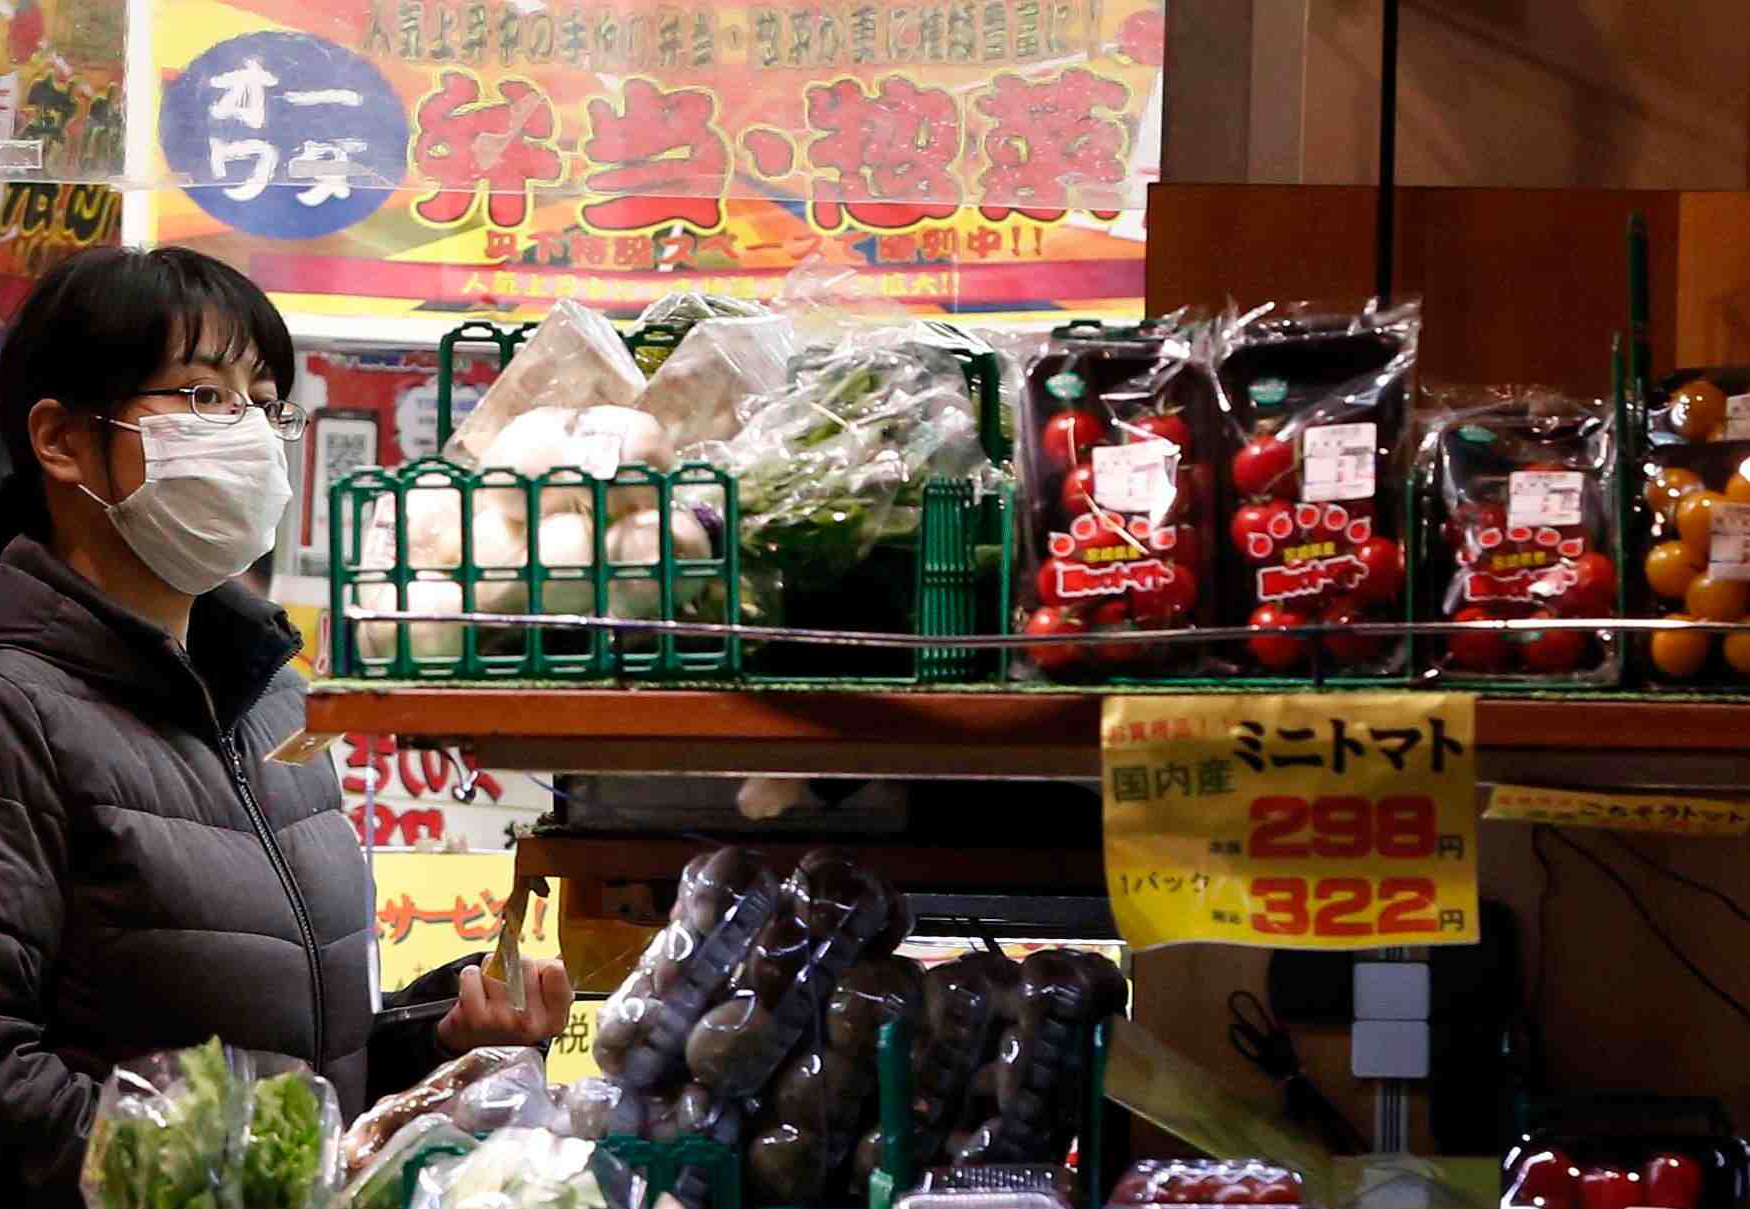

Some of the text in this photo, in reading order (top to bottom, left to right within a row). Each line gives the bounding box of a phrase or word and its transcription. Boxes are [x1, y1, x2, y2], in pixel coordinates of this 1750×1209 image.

[1234, 717, 1463, 774] ミニトマト
[1112, 759, 1236, 803] 国内産
[1249, 795, 1438, 860] 298
[1439, 834, 1464, 861] 円
[1119, 870, 1211, 896] 1パック
[1249, 876, 1438, 937] 322
[1440, 908, 1464, 932] 円
